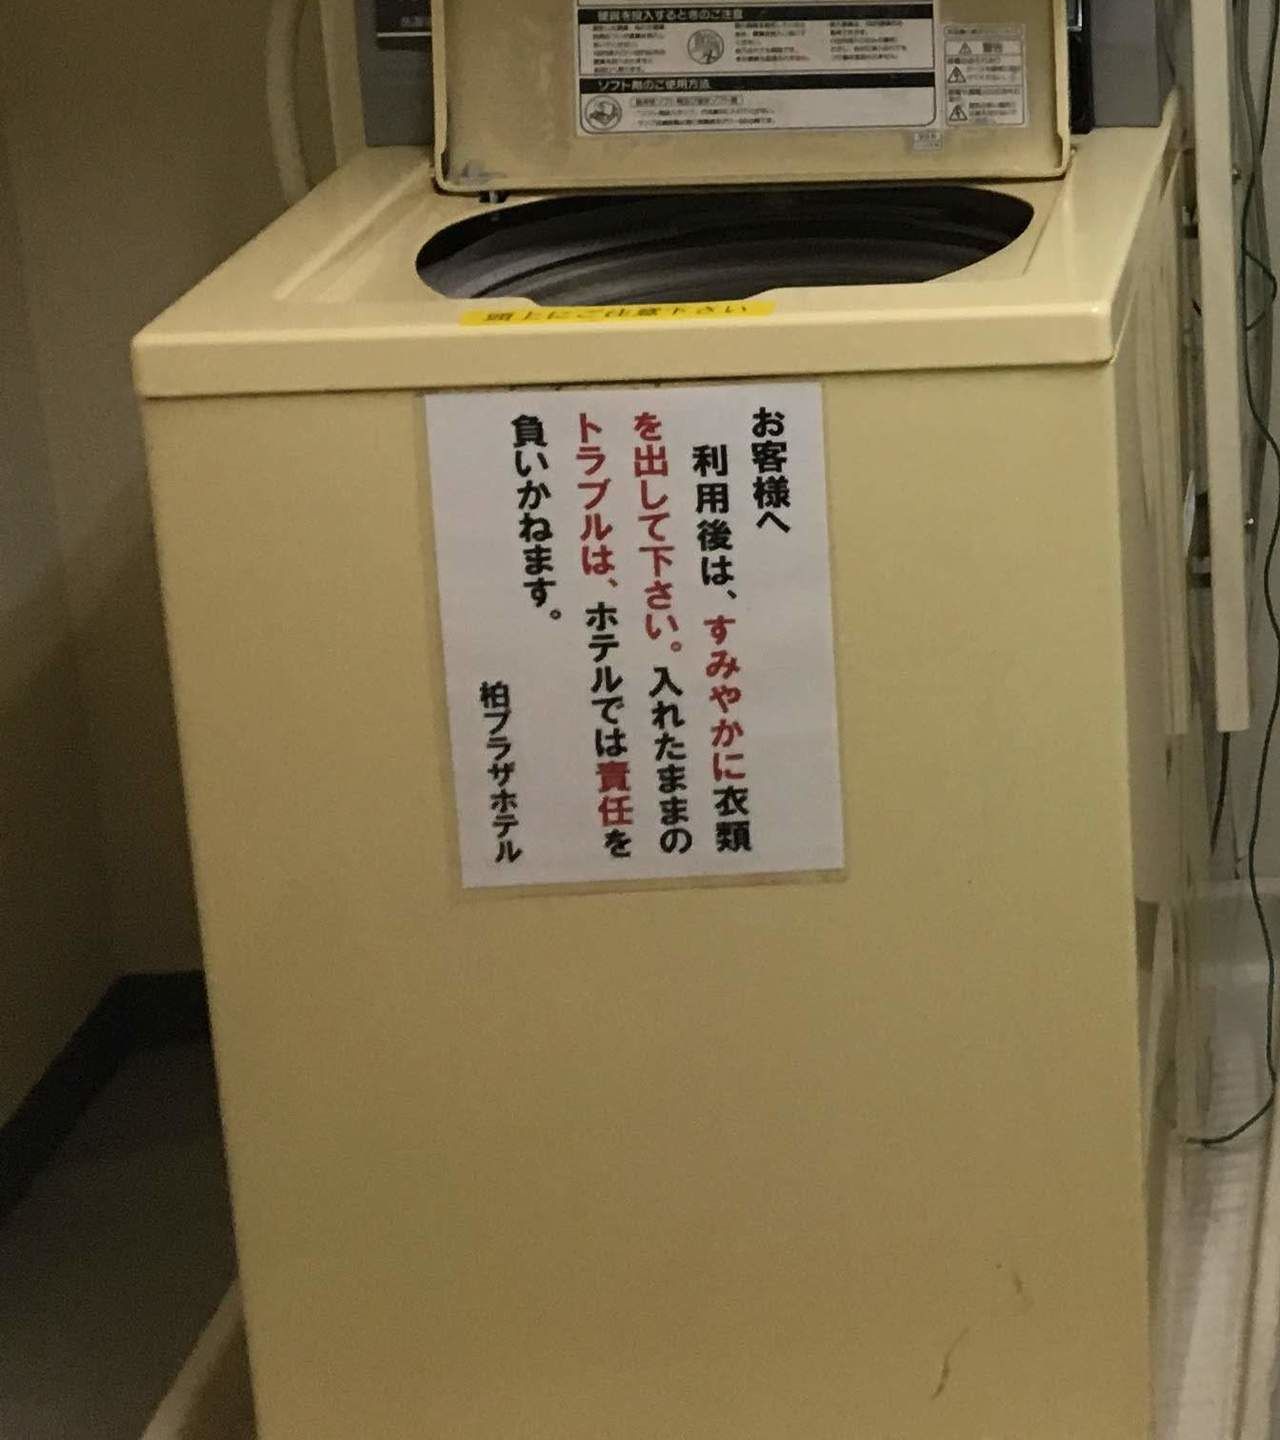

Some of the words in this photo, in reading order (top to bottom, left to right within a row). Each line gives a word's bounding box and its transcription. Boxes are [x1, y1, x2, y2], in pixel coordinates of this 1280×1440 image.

[511, 414, 562, 621] 負いかねます。
[752, 407, 791, 534] お客様へ
[480, 680, 522, 863] 柏プラザホテル
